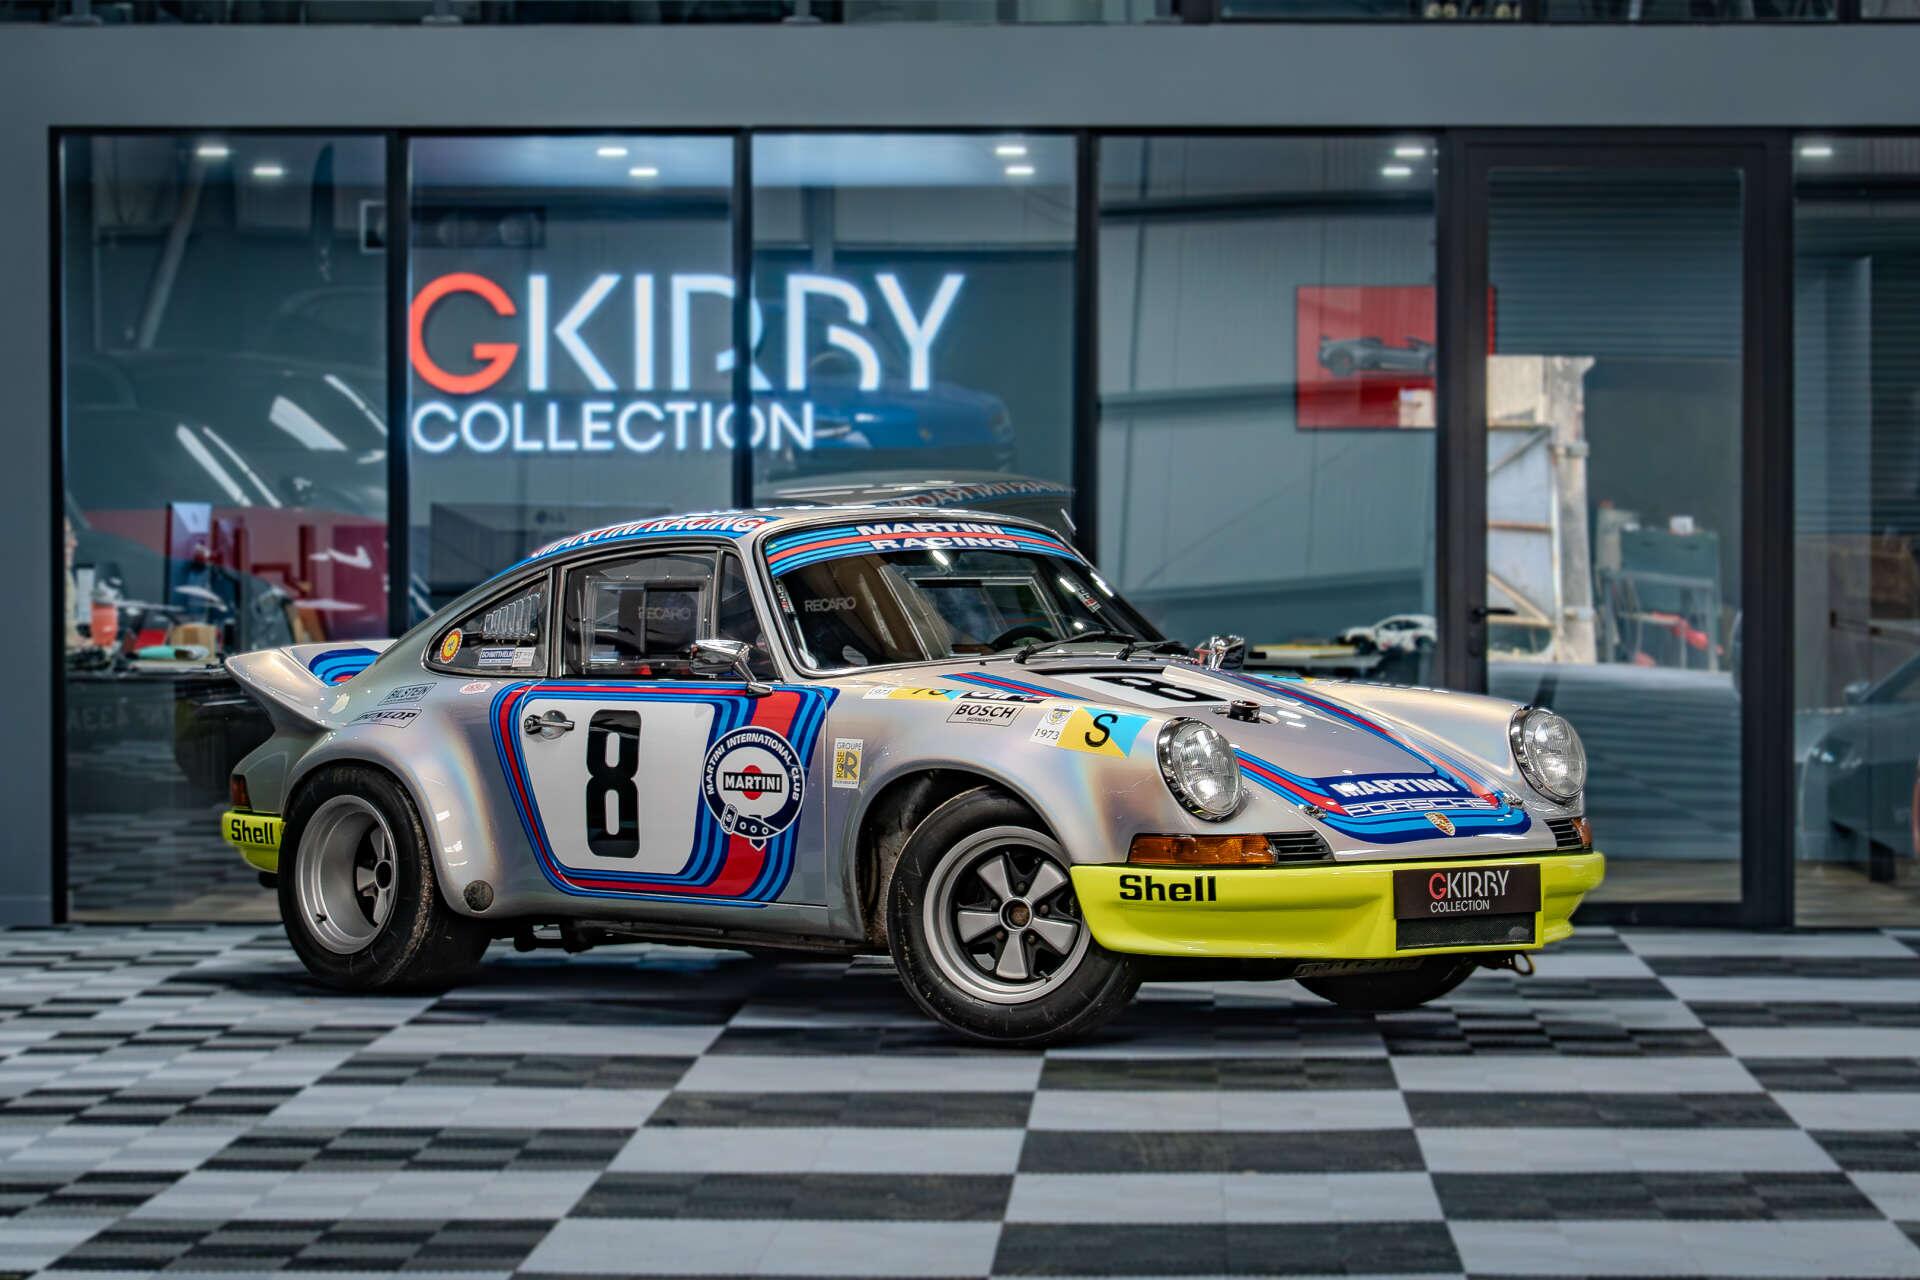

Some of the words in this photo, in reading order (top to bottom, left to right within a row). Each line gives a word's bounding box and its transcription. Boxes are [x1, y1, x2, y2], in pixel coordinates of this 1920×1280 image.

[408, 272, 965, 394] GKIRBY
[411, 401, 815, 452] COLLECTION
[645, 515, 768, 533] RACING
[856, 522, 1005, 536] MARTINI
[870, 537, 1019, 550] RACING
[638, 606, 691, 620] RECARO
[804, 596, 857, 613] RECARO
[955, 704, 1016, 719] BOSCH
[1034, 728, 1060, 740] 1973
[1085, 713, 1118, 748] S
[705, 745, 726, 795] MARTINI
[726, 733, 793, 765] INTERNATIONAL
[791, 767, 801, 801] CLUB
[586, 709, 642, 859] 8
[724, 775, 781, 791] MARTINI
[1329, 779, 1458, 797] MARTINI
[1342, 797, 1497, 817] PORSCHE
[231, 819, 274, 845] Shell
[1119, 874, 1217, 902] Shell
[1429, 870, 1510, 900] GKIRBY
[1431, 900, 1490, 913] COLLECTION
